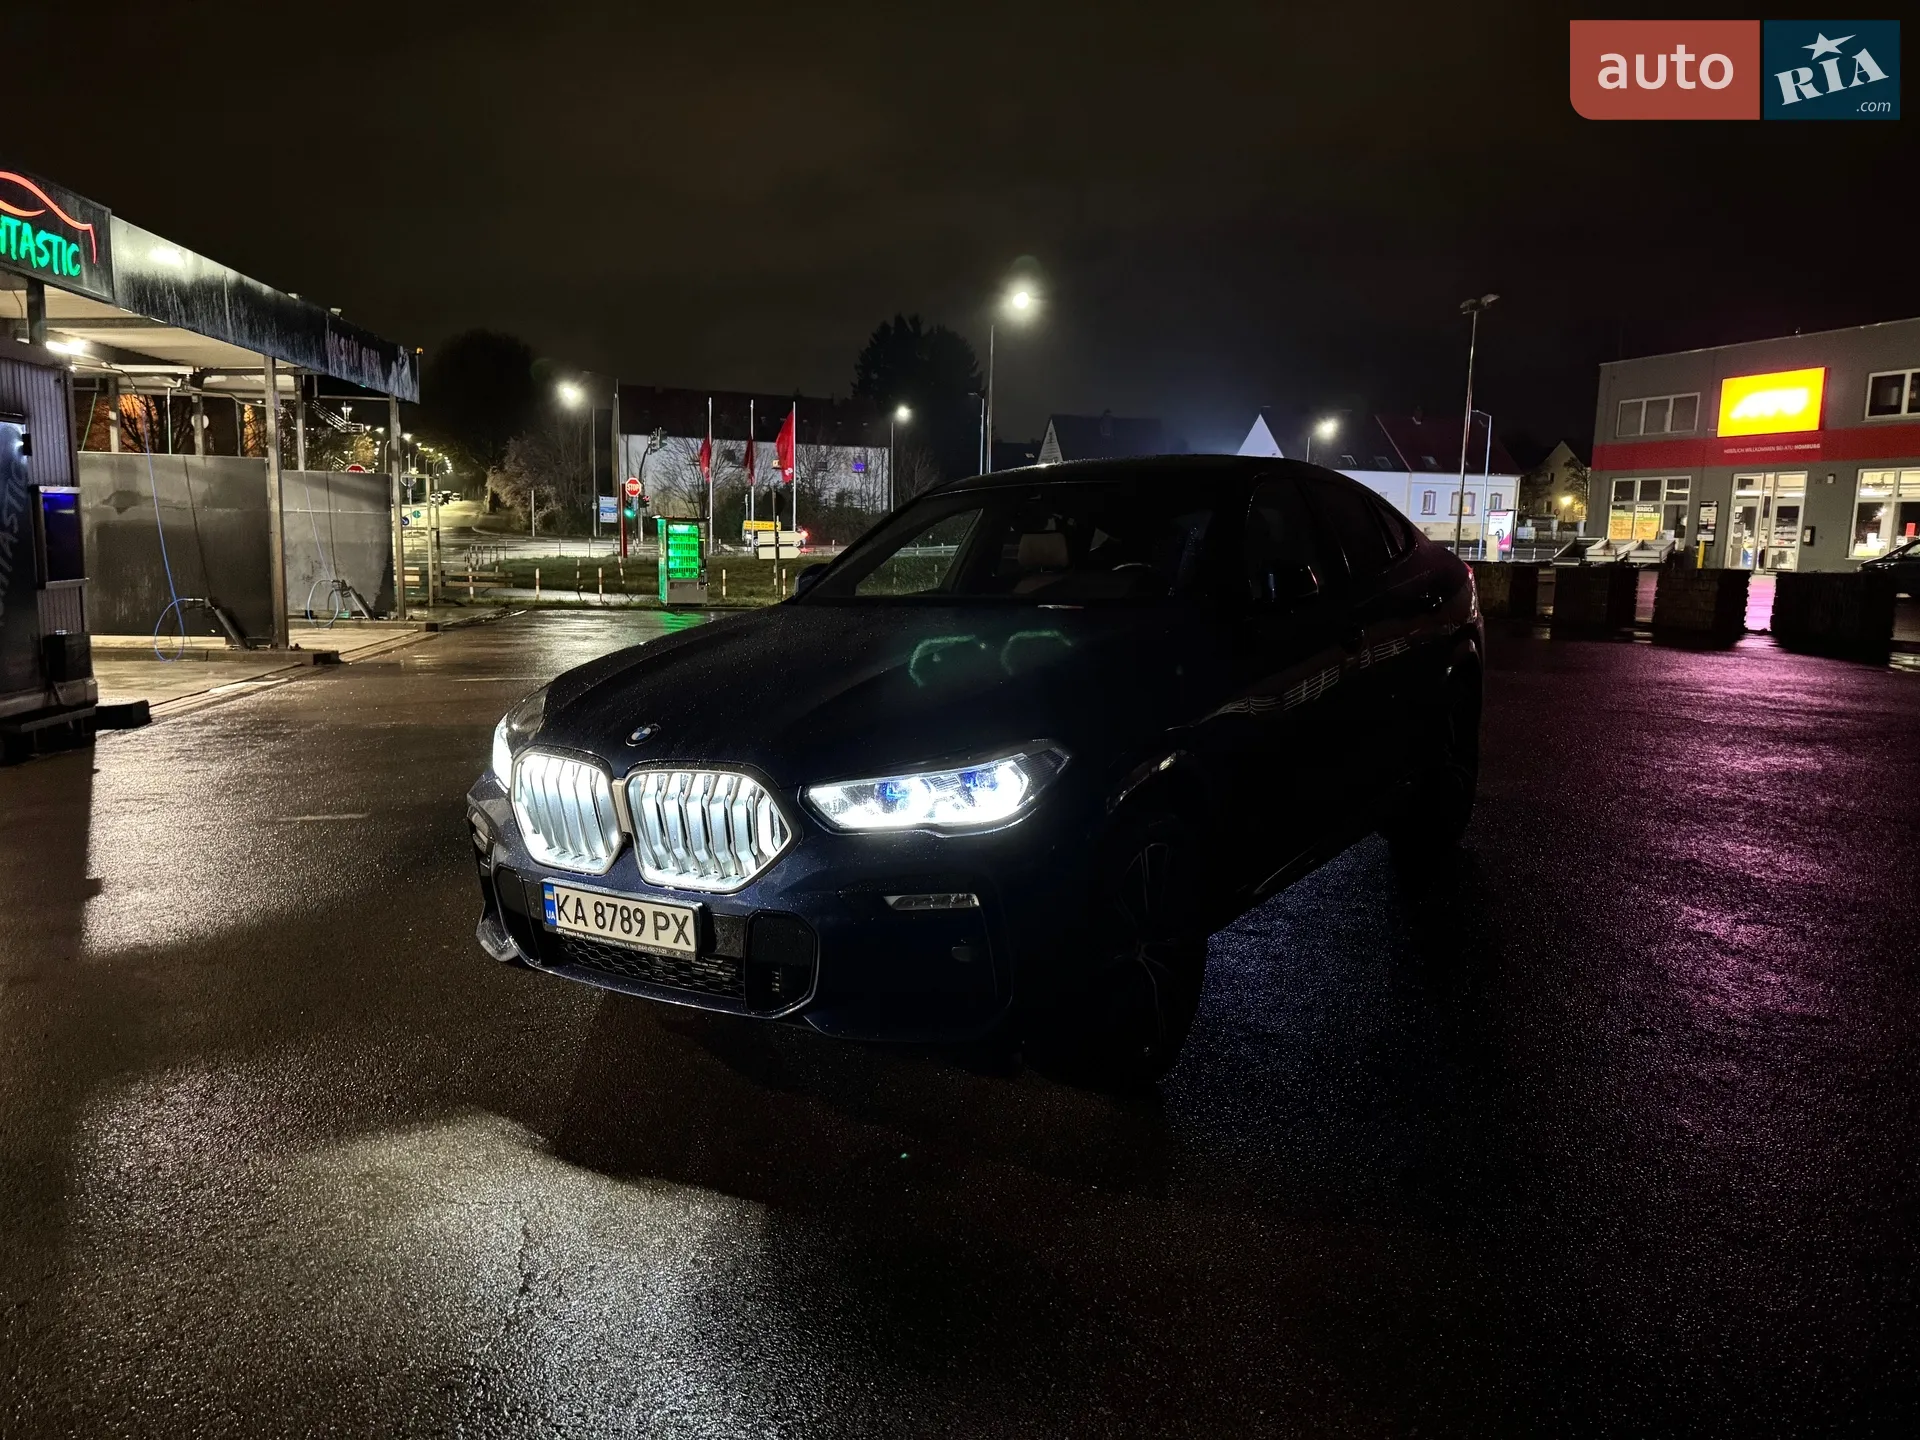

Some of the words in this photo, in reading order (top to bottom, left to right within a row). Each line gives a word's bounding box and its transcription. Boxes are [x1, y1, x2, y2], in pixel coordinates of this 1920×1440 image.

[627, 483, 640, 491] STOP
[546, 909, 556, 921] UA
[556, 893, 588, 927] KA
[593, 900, 646, 937] 8789
[653, 910, 691, 946] PX
